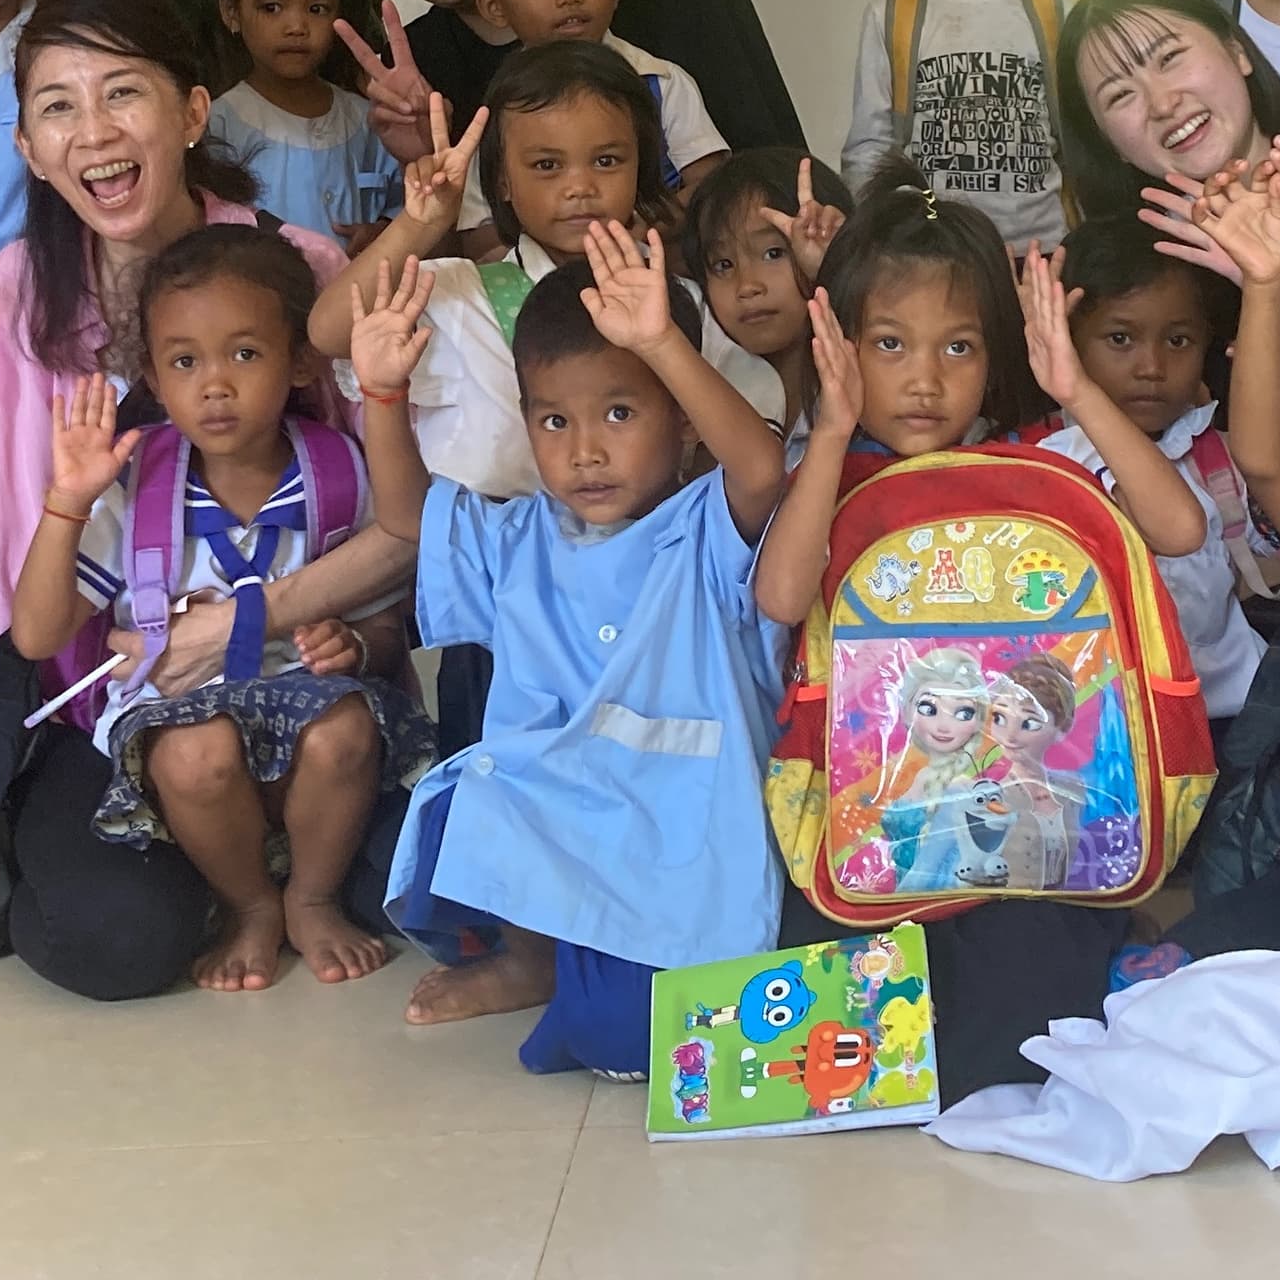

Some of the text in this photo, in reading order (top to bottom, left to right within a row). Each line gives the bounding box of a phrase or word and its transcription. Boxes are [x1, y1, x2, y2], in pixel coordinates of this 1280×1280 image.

[917, 51, 1019, 83] WINKLE
[983, 107, 1010, 121] YOU
[922, 121, 944, 142] UP
[950, 120, 1015, 142] ABOVE
[978, 141, 1008, 157] SO
[946, 172, 1001, 192] THE
[1014, 173, 1048, 193] SKY
